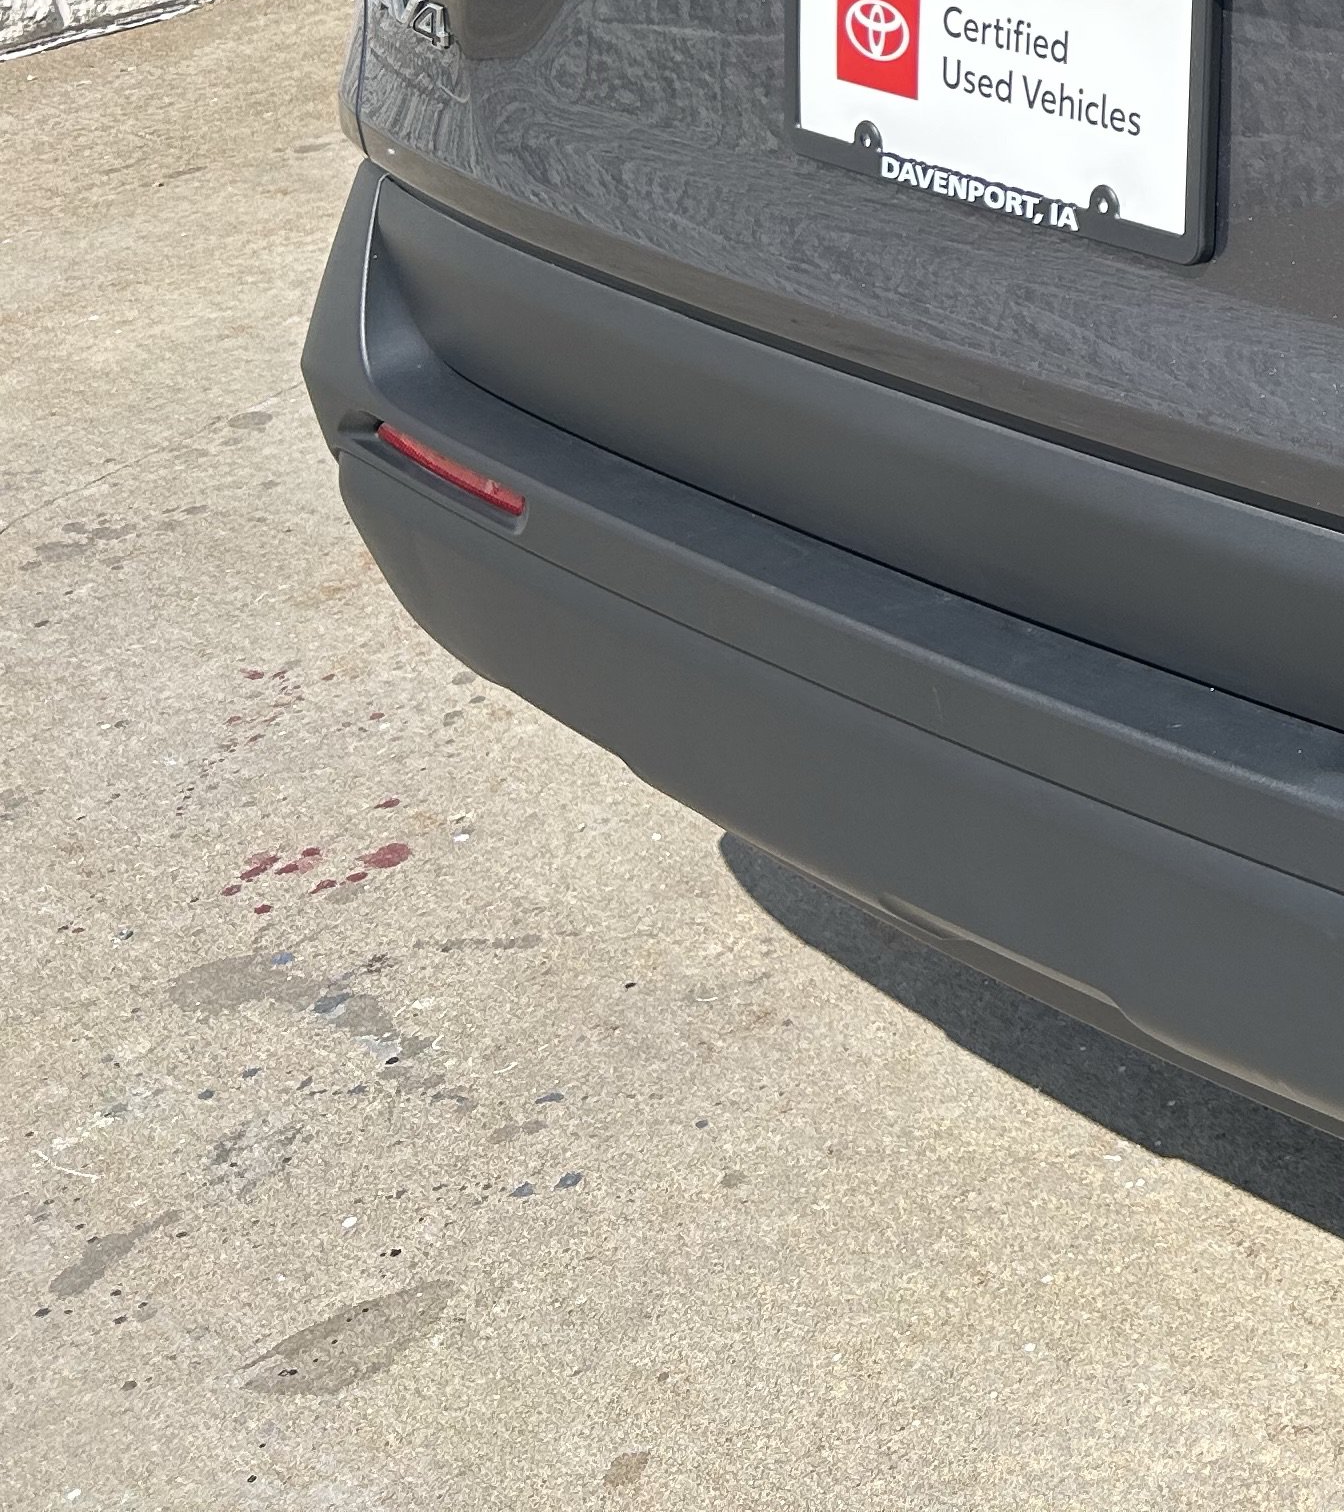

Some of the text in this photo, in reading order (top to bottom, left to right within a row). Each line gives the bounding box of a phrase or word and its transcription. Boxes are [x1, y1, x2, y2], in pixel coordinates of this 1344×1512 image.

[942, 6, 1069, 65] Certified
[942, 56, 1142, 137] Used Vehicles
[881, 155, 1080, 232] DAVENPORT, IA
